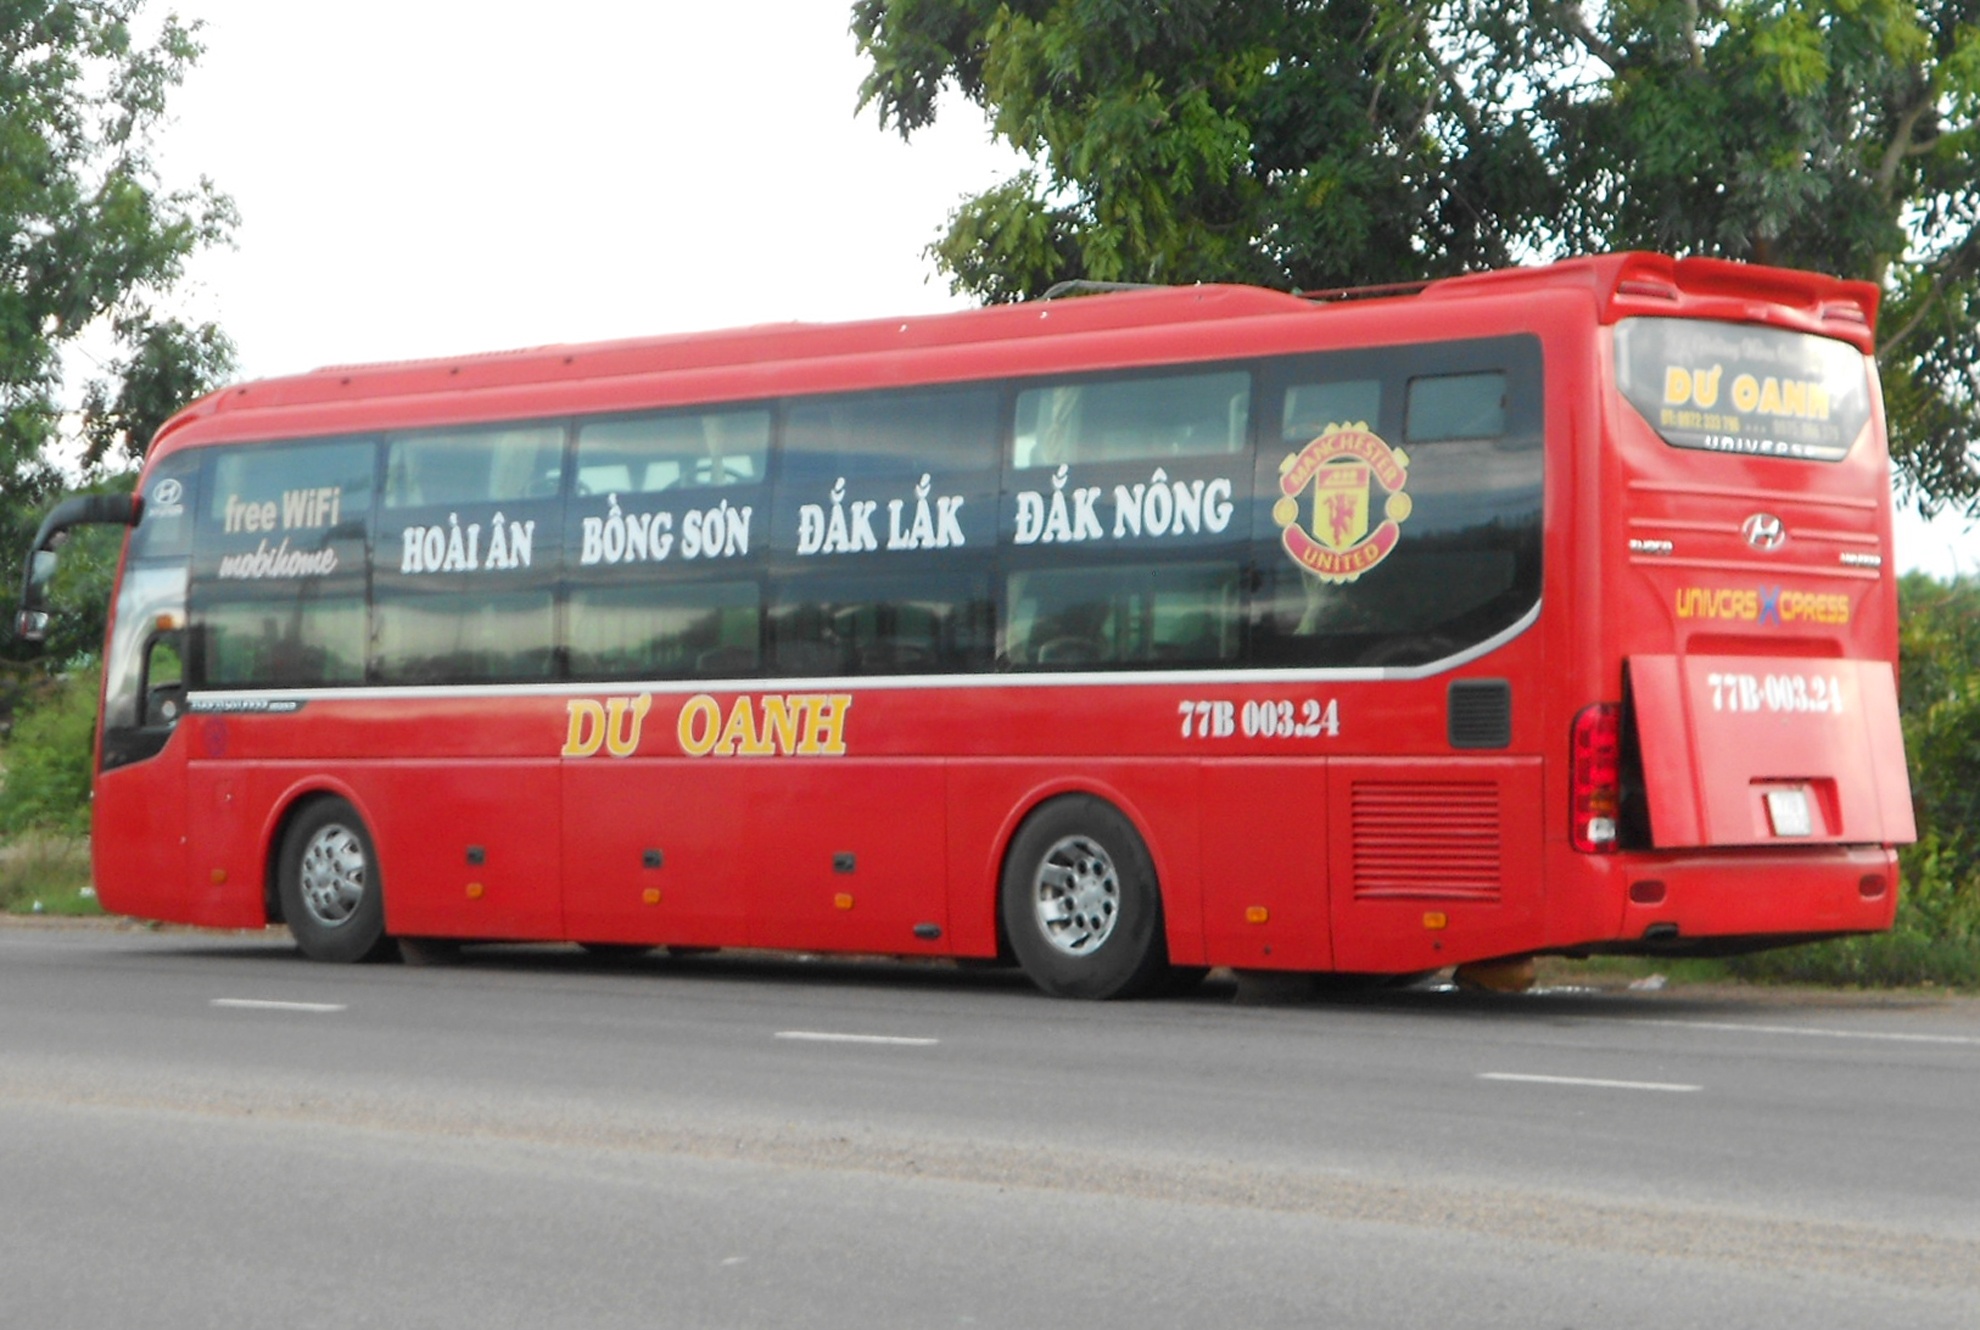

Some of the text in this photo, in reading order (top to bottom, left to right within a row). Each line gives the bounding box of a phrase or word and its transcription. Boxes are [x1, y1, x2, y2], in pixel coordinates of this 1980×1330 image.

[1665, 364, 1830, 420] DƯ OANH
[1290, 433, 1398, 484] MANCHESTER
[225, 487, 340, 533] free WiFi
[580, 493, 752, 565] BỒNG SƠN
[796, 472, 965, 555] ĐẮK LẮK
[1013, 464, 1235, 545] ĐẮK NÔNG
[219, 537, 338, 579] mobihome
[400, 511, 535, 574] HOÀI ÂN
[1303, 543, 1379, 571] UNITED
[562, 693, 852, 756] DƯ OANH
[1178, 699, 1340, 738] 77B 003.24
